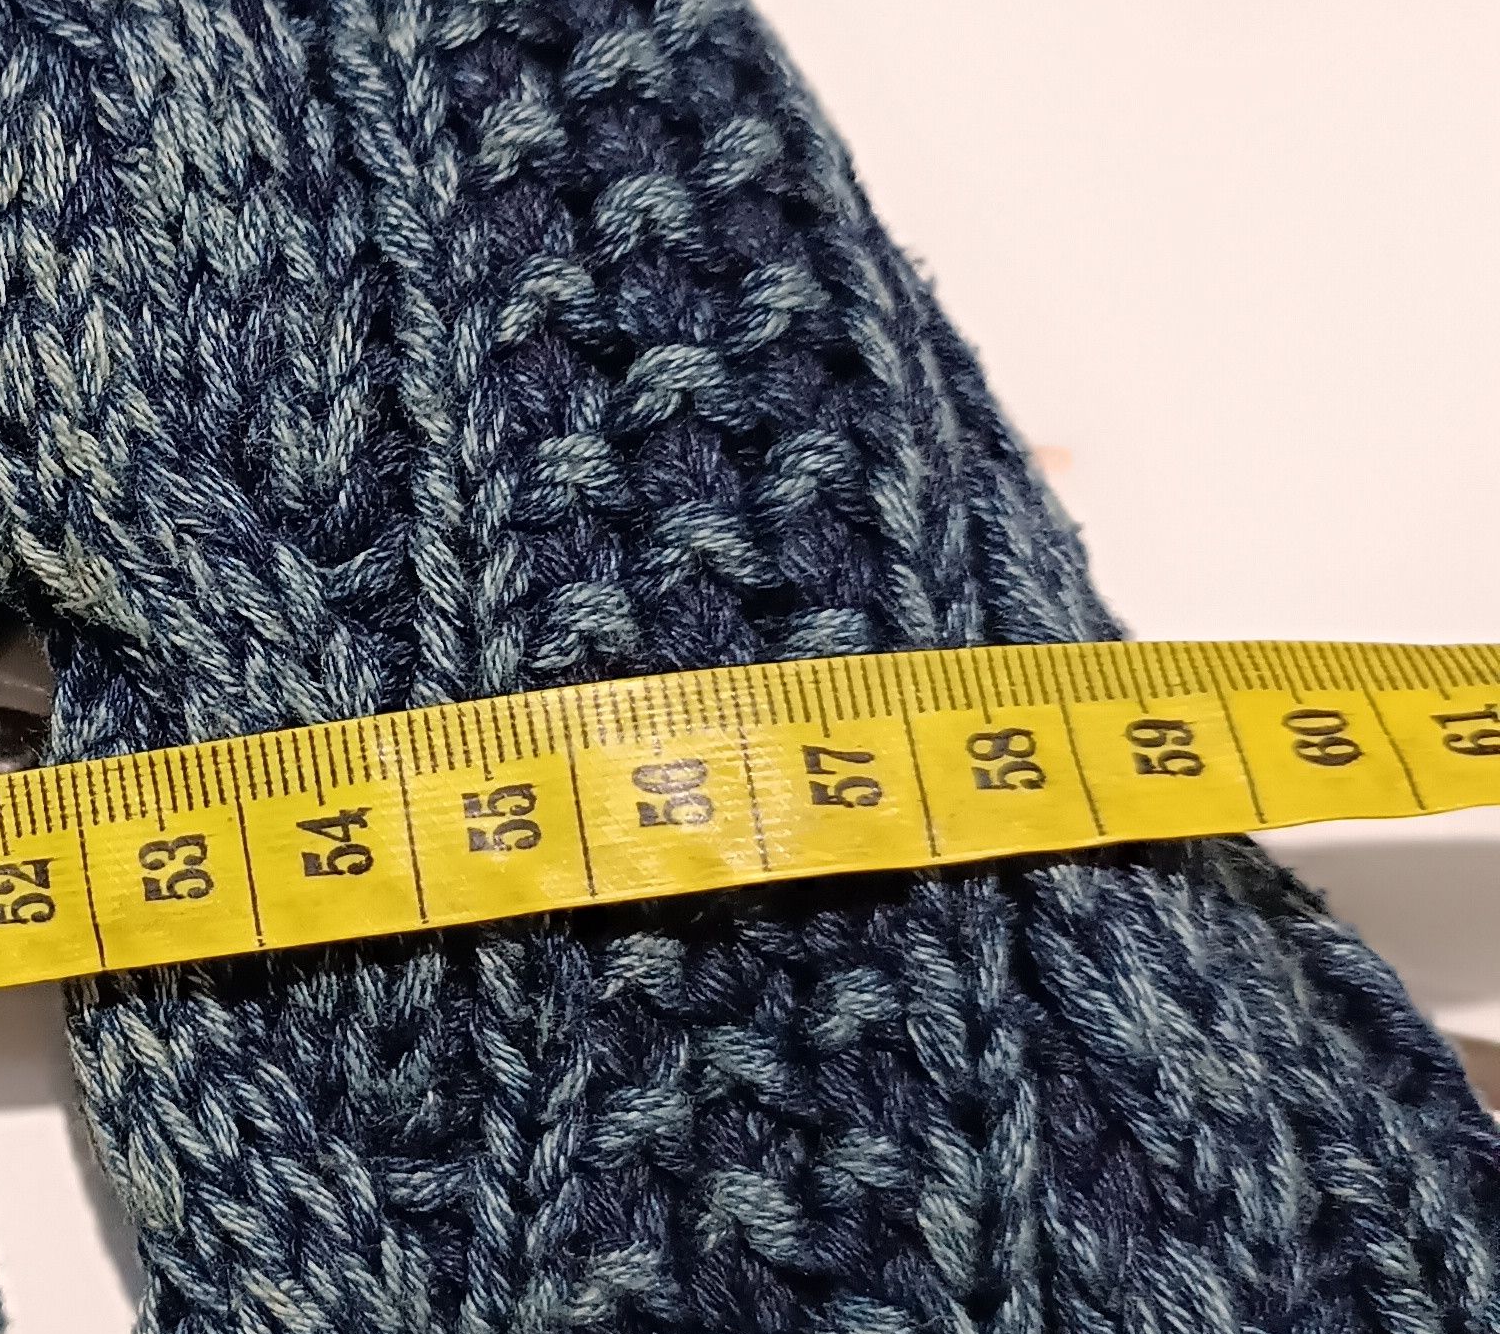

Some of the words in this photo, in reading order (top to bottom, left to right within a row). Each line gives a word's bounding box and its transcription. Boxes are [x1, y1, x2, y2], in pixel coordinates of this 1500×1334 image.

[966, 726, 1047, 791] 58
[1126, 717, 1206, 777] 59
[1281, 708, 1364, 767] 60
[631, 758, 715, 828] 56
[801, 743, 884, 808] 57
[295, 806, 375, 878] 54
[461, 783, 542, 853] 55
[136, 833, 215, 901] 53
